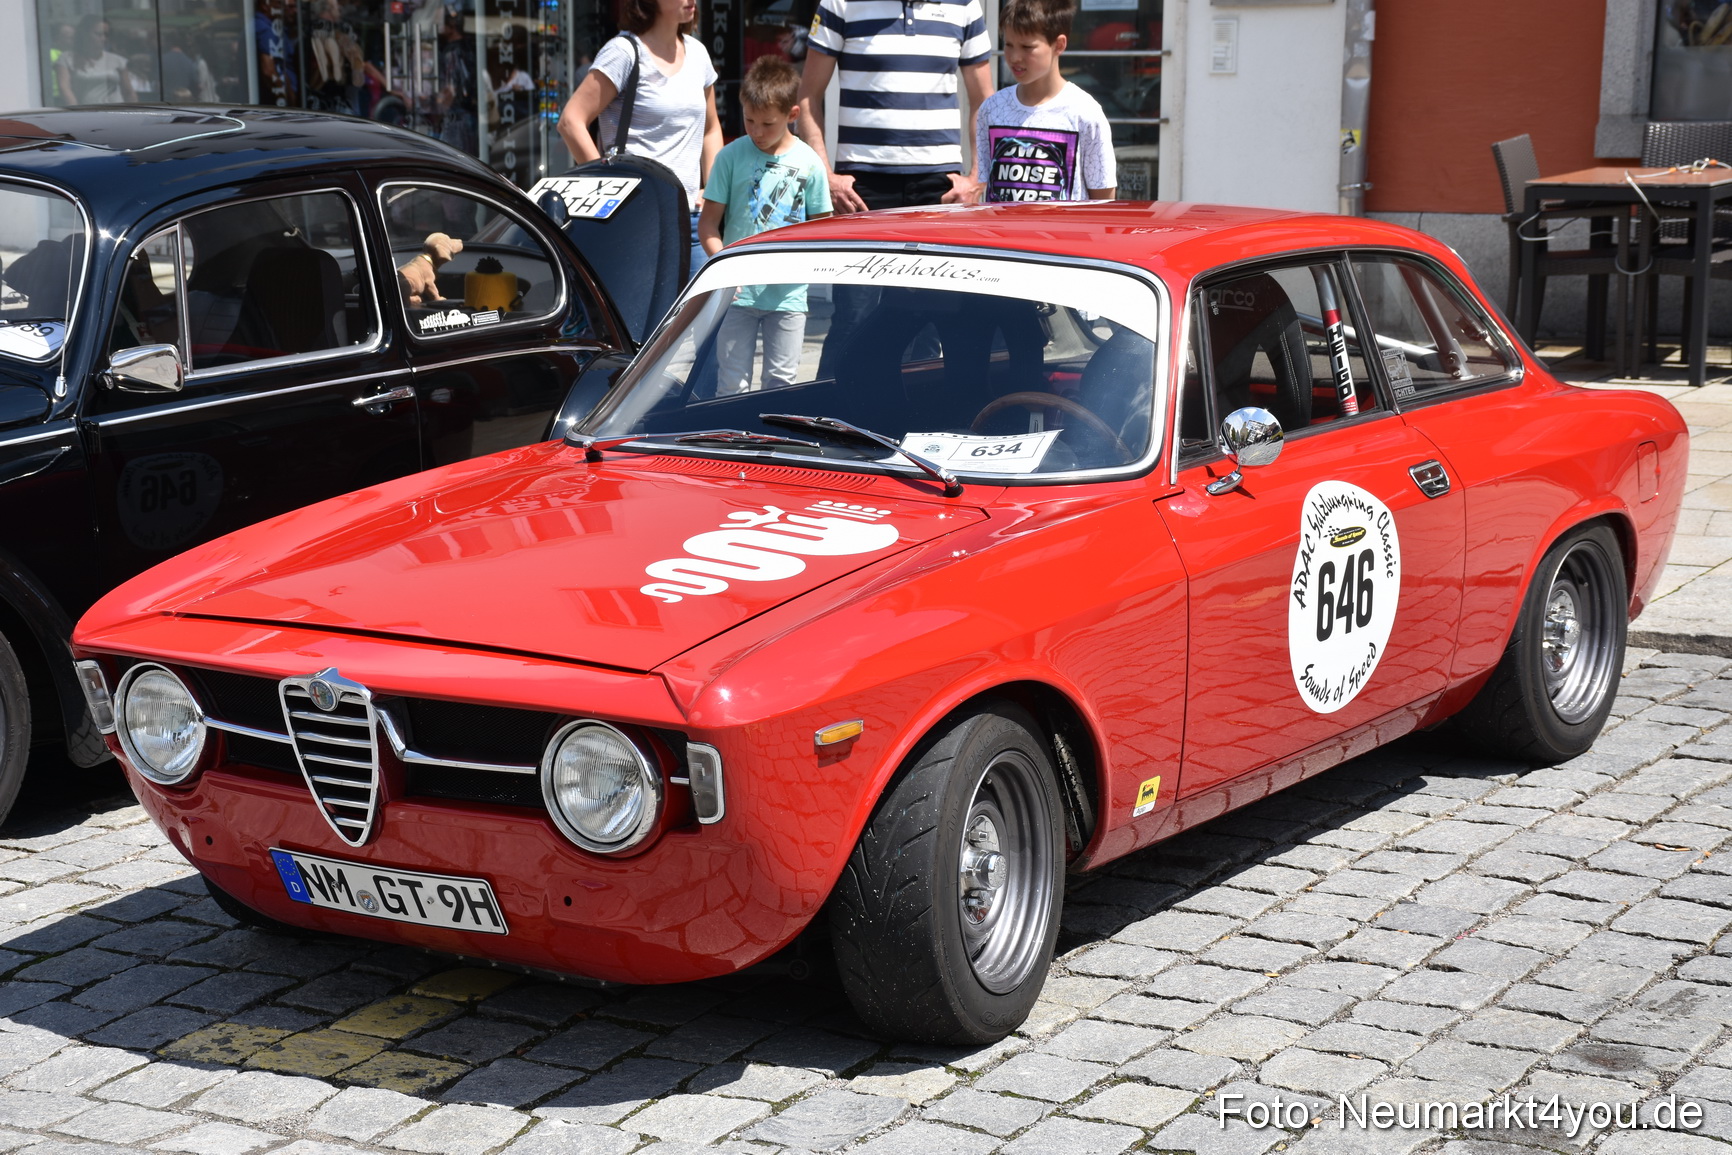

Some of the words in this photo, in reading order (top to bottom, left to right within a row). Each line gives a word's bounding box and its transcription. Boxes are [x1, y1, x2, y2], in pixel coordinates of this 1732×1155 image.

[998, 163, 1058, 184] NOISE
[1328, 323, 1352, 398] HEIGO
[970, 442, 1023, 457] 634
[1293, 533, 1316, 610] ADAC
[1376, 511, 1396, 579] Classic
[1316, 548, 1375, 642] 646
[1300, 663, 1330, 705] Sounds
[1333, 674, 1346, 704] of
[1348, 642, 1377, 694] Speed
[292, 881, 301, 893] D
[294, 860, 356, 907] NM
[373, 875, 428, 918] GT
[437, 884, 500, 927] 9H
